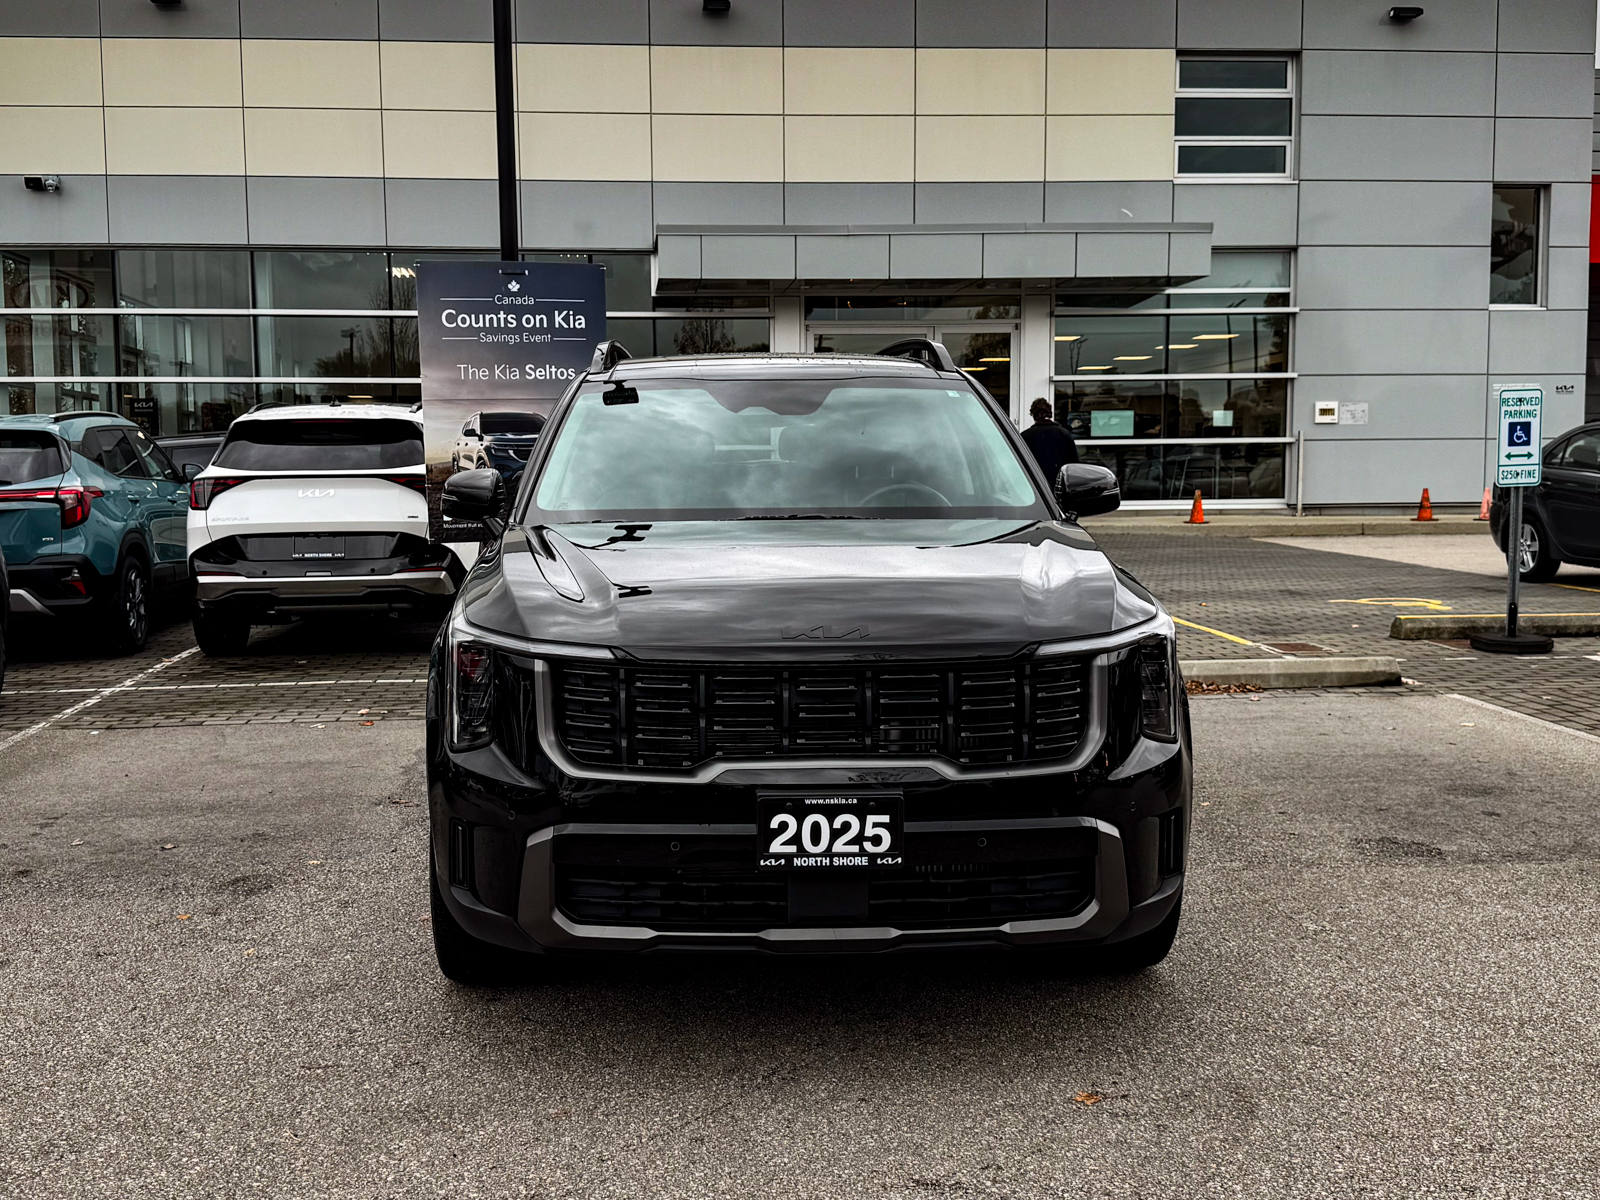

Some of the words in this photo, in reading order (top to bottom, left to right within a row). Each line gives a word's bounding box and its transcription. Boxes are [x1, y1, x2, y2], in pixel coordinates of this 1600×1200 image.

[494, 295, 534, 305] Canada
[441, 309, 517, 328] Counts
[521, 314, 548, 328] on
[554, 310, 586, 329] Kia
[479, 333, 520, 345] Savings
[523, 333, 551, 343] Event
[457, 364, 489, 380] The
[494, 365, 520, 380] Kia
[525, 364, 576, 380] Seltos
[1501, 396, 1540, 407] RESERVED
[1504, 409, 1537, 419] PARKING
[1501, 470, 1519, 480] $250
[1520, 469, 1537, 479] FINE
[298, 489, 335, 498] KIA
[780, 624, 870, 639] KIA
[769, 813, 892, 853] 2025
[760, 858, 785, 866] KIA
[793, 857, 830, 866] NORTH
[832, 857, 869, 866] SHORE
[877, 857, 902, 865] KIA
